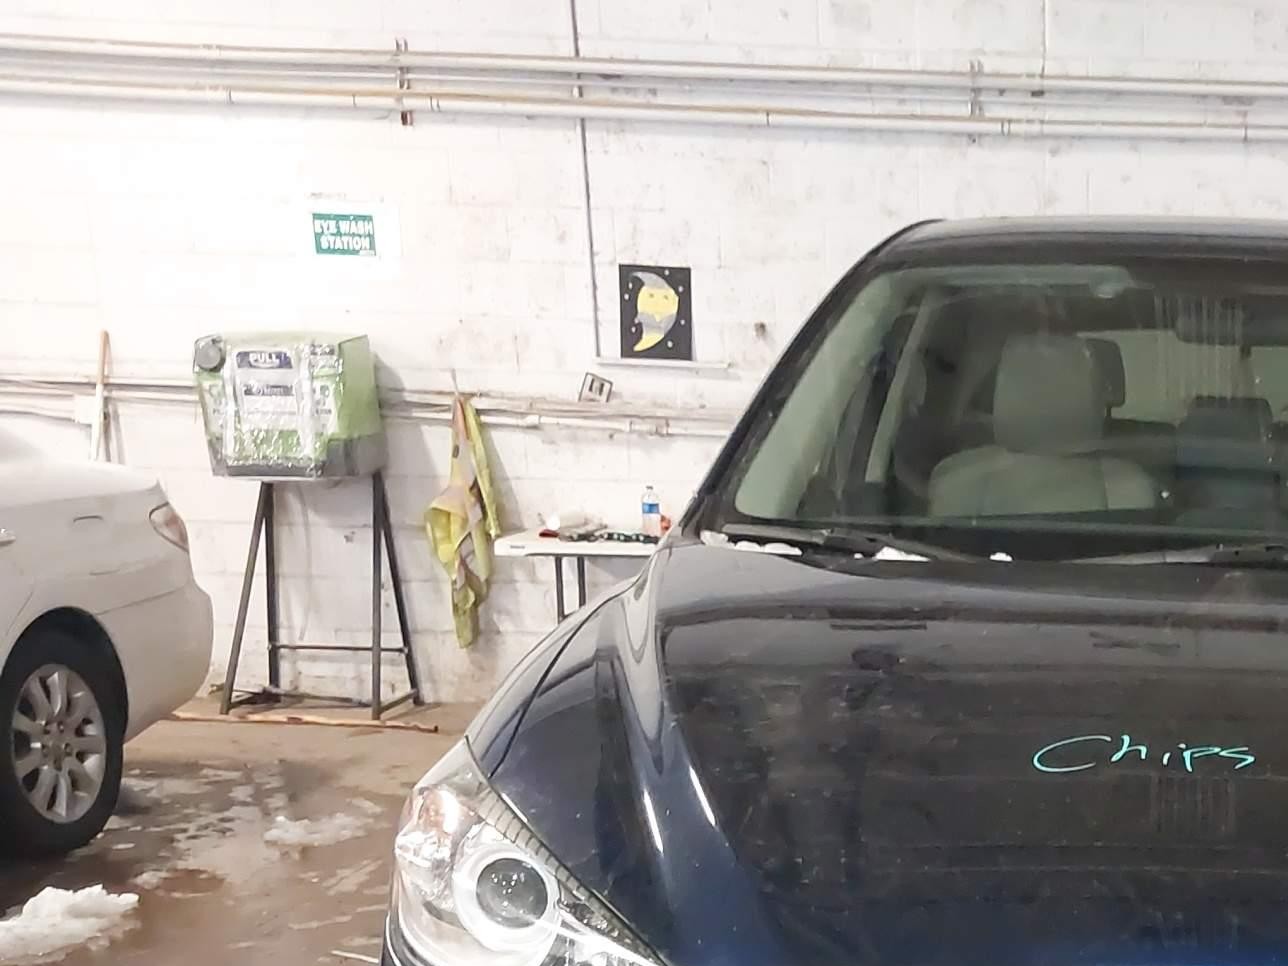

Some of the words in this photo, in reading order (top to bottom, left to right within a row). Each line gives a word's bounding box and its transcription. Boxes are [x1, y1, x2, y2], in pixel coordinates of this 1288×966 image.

[314, 219, 338, 234] EYE
[338, 219, 373, 235] WASH
[320, 235, 370, 250] STATION
[249, 353, 280, 364] PULL
